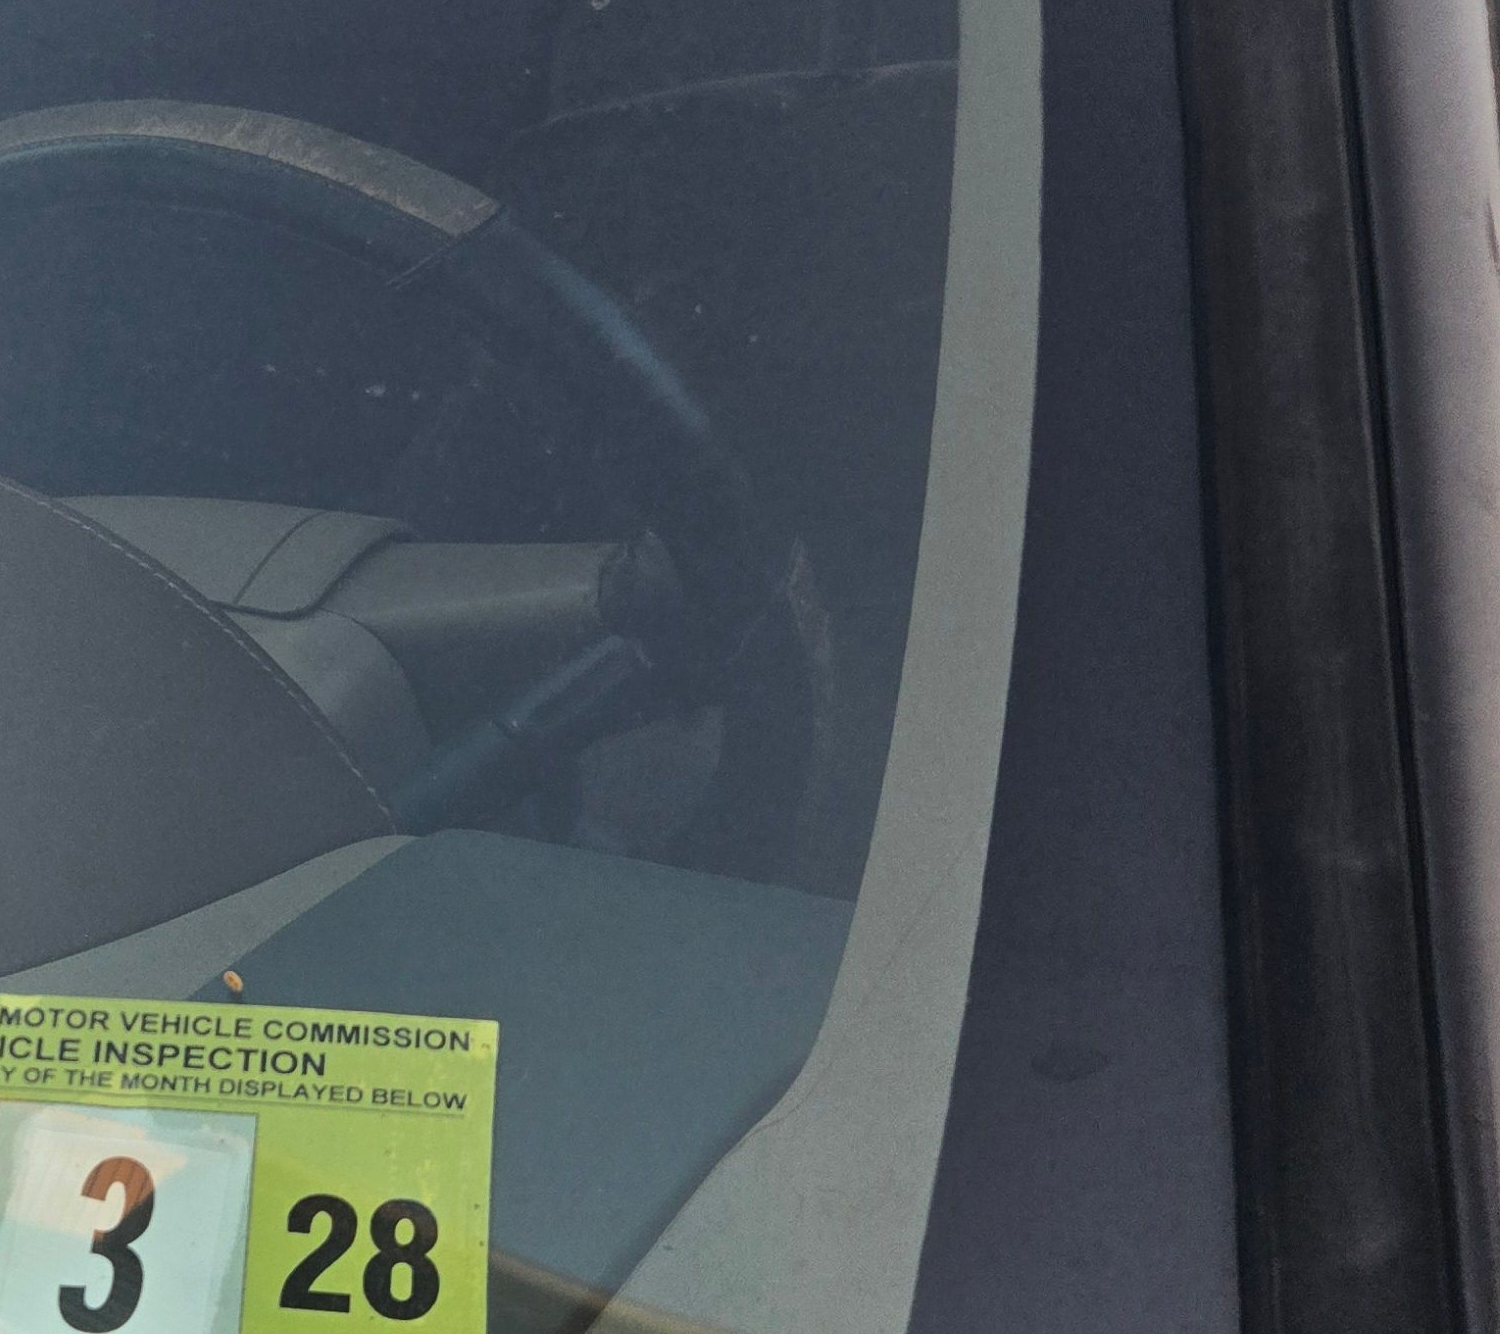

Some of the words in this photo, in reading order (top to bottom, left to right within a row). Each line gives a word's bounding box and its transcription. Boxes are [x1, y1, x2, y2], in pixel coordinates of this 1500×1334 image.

[120, 1012, 254, 1040] VEHICLE
[263, 1019, 472, 1053] COMMISSION
[93, 1039, 327, 1077] INSPECTION
[23, 1066, 56, 1085] OF
[64, 1068, 114, 1088] THE
[119, 1071, 211, 1094] MONTH
[218, 1079, 363, 1105] DISPLAYED
[371, 1088, 467, 1111] BELOW
[58, 1155, 156, 1334] 3
[279, 1192, 441, 1321] 28
